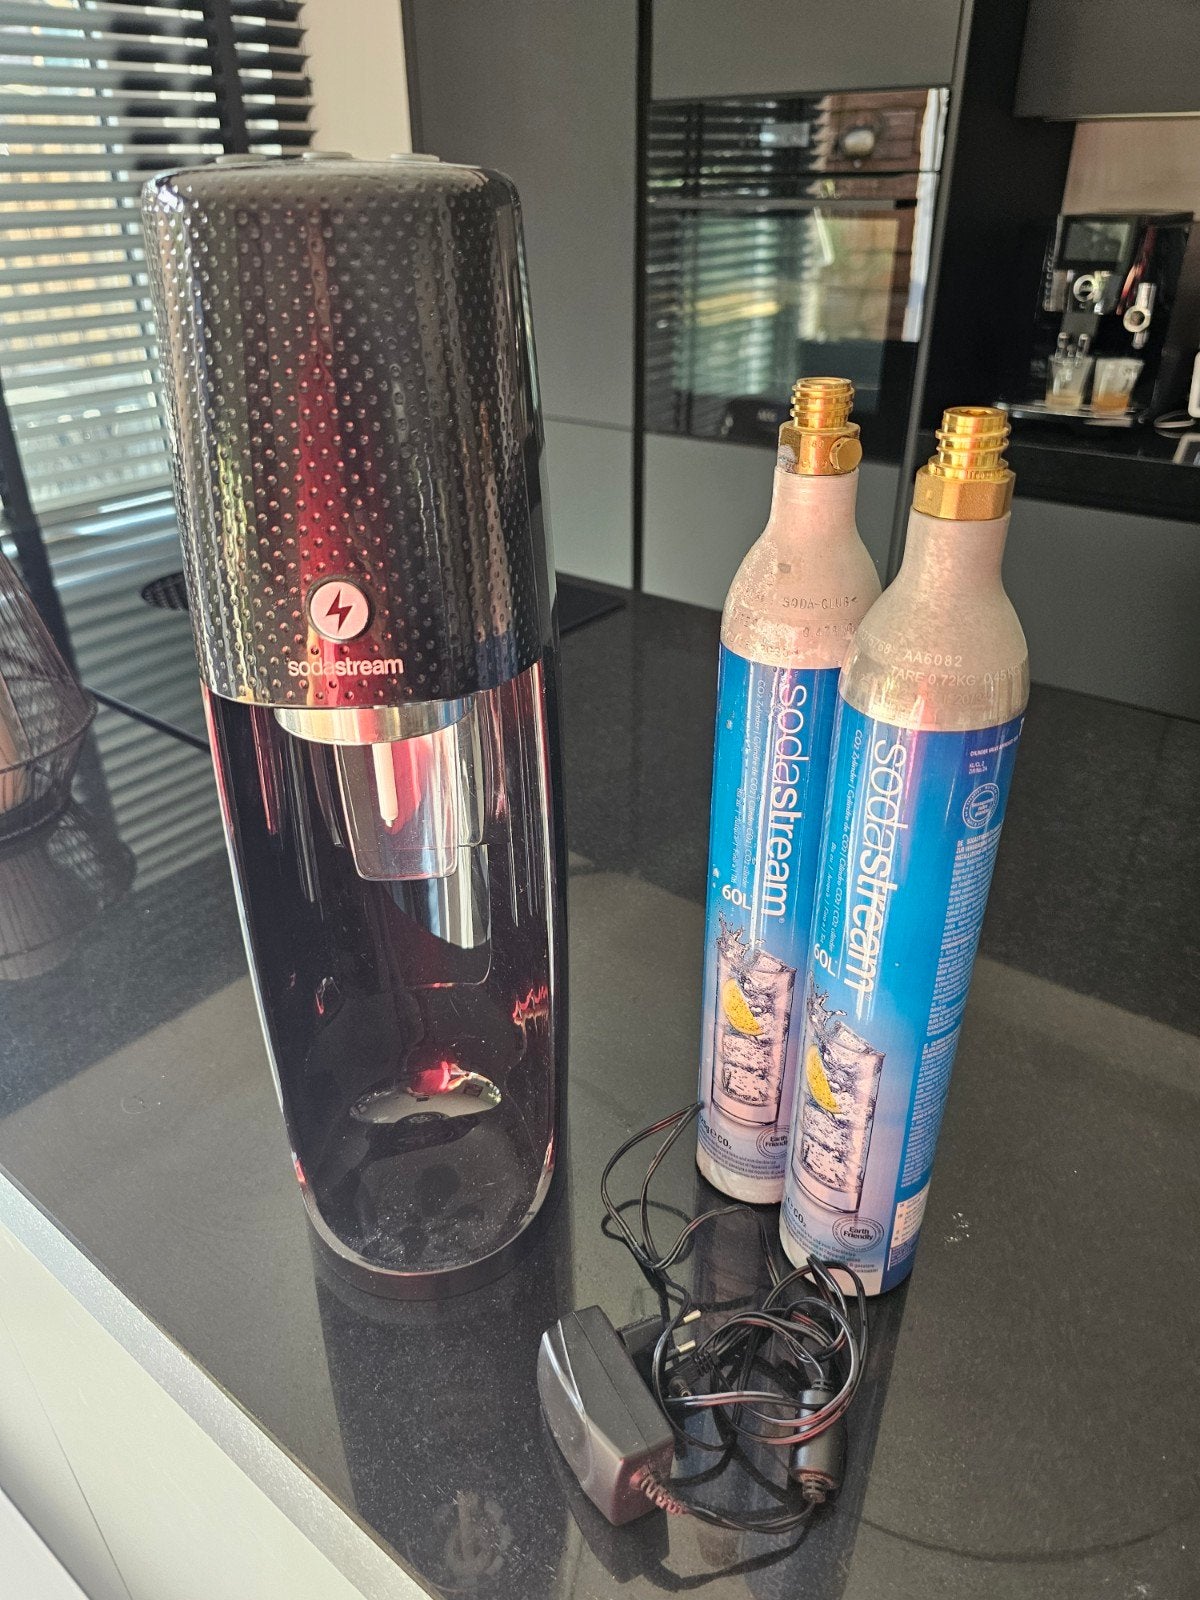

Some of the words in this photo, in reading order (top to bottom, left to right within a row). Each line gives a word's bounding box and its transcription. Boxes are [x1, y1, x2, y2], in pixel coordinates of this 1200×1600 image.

[288, 658, 404, 677] sodastream
[903, 650, 963, 668] AA6082
[891, 665, 924, 682] TARE
[850, 751, 860, 780] Zylinder
[761, 685, 809, 916] sodastream
[845, 789, 855, 820] Cylindre
[844, 740, 908, 992] sodastream
[722, 884, 752, 910] 60L
[814, 943, 836, 977] 60L
[843, 1230, 874, 1241] Friendly
[849, 1226, 870, 1235] Earth
